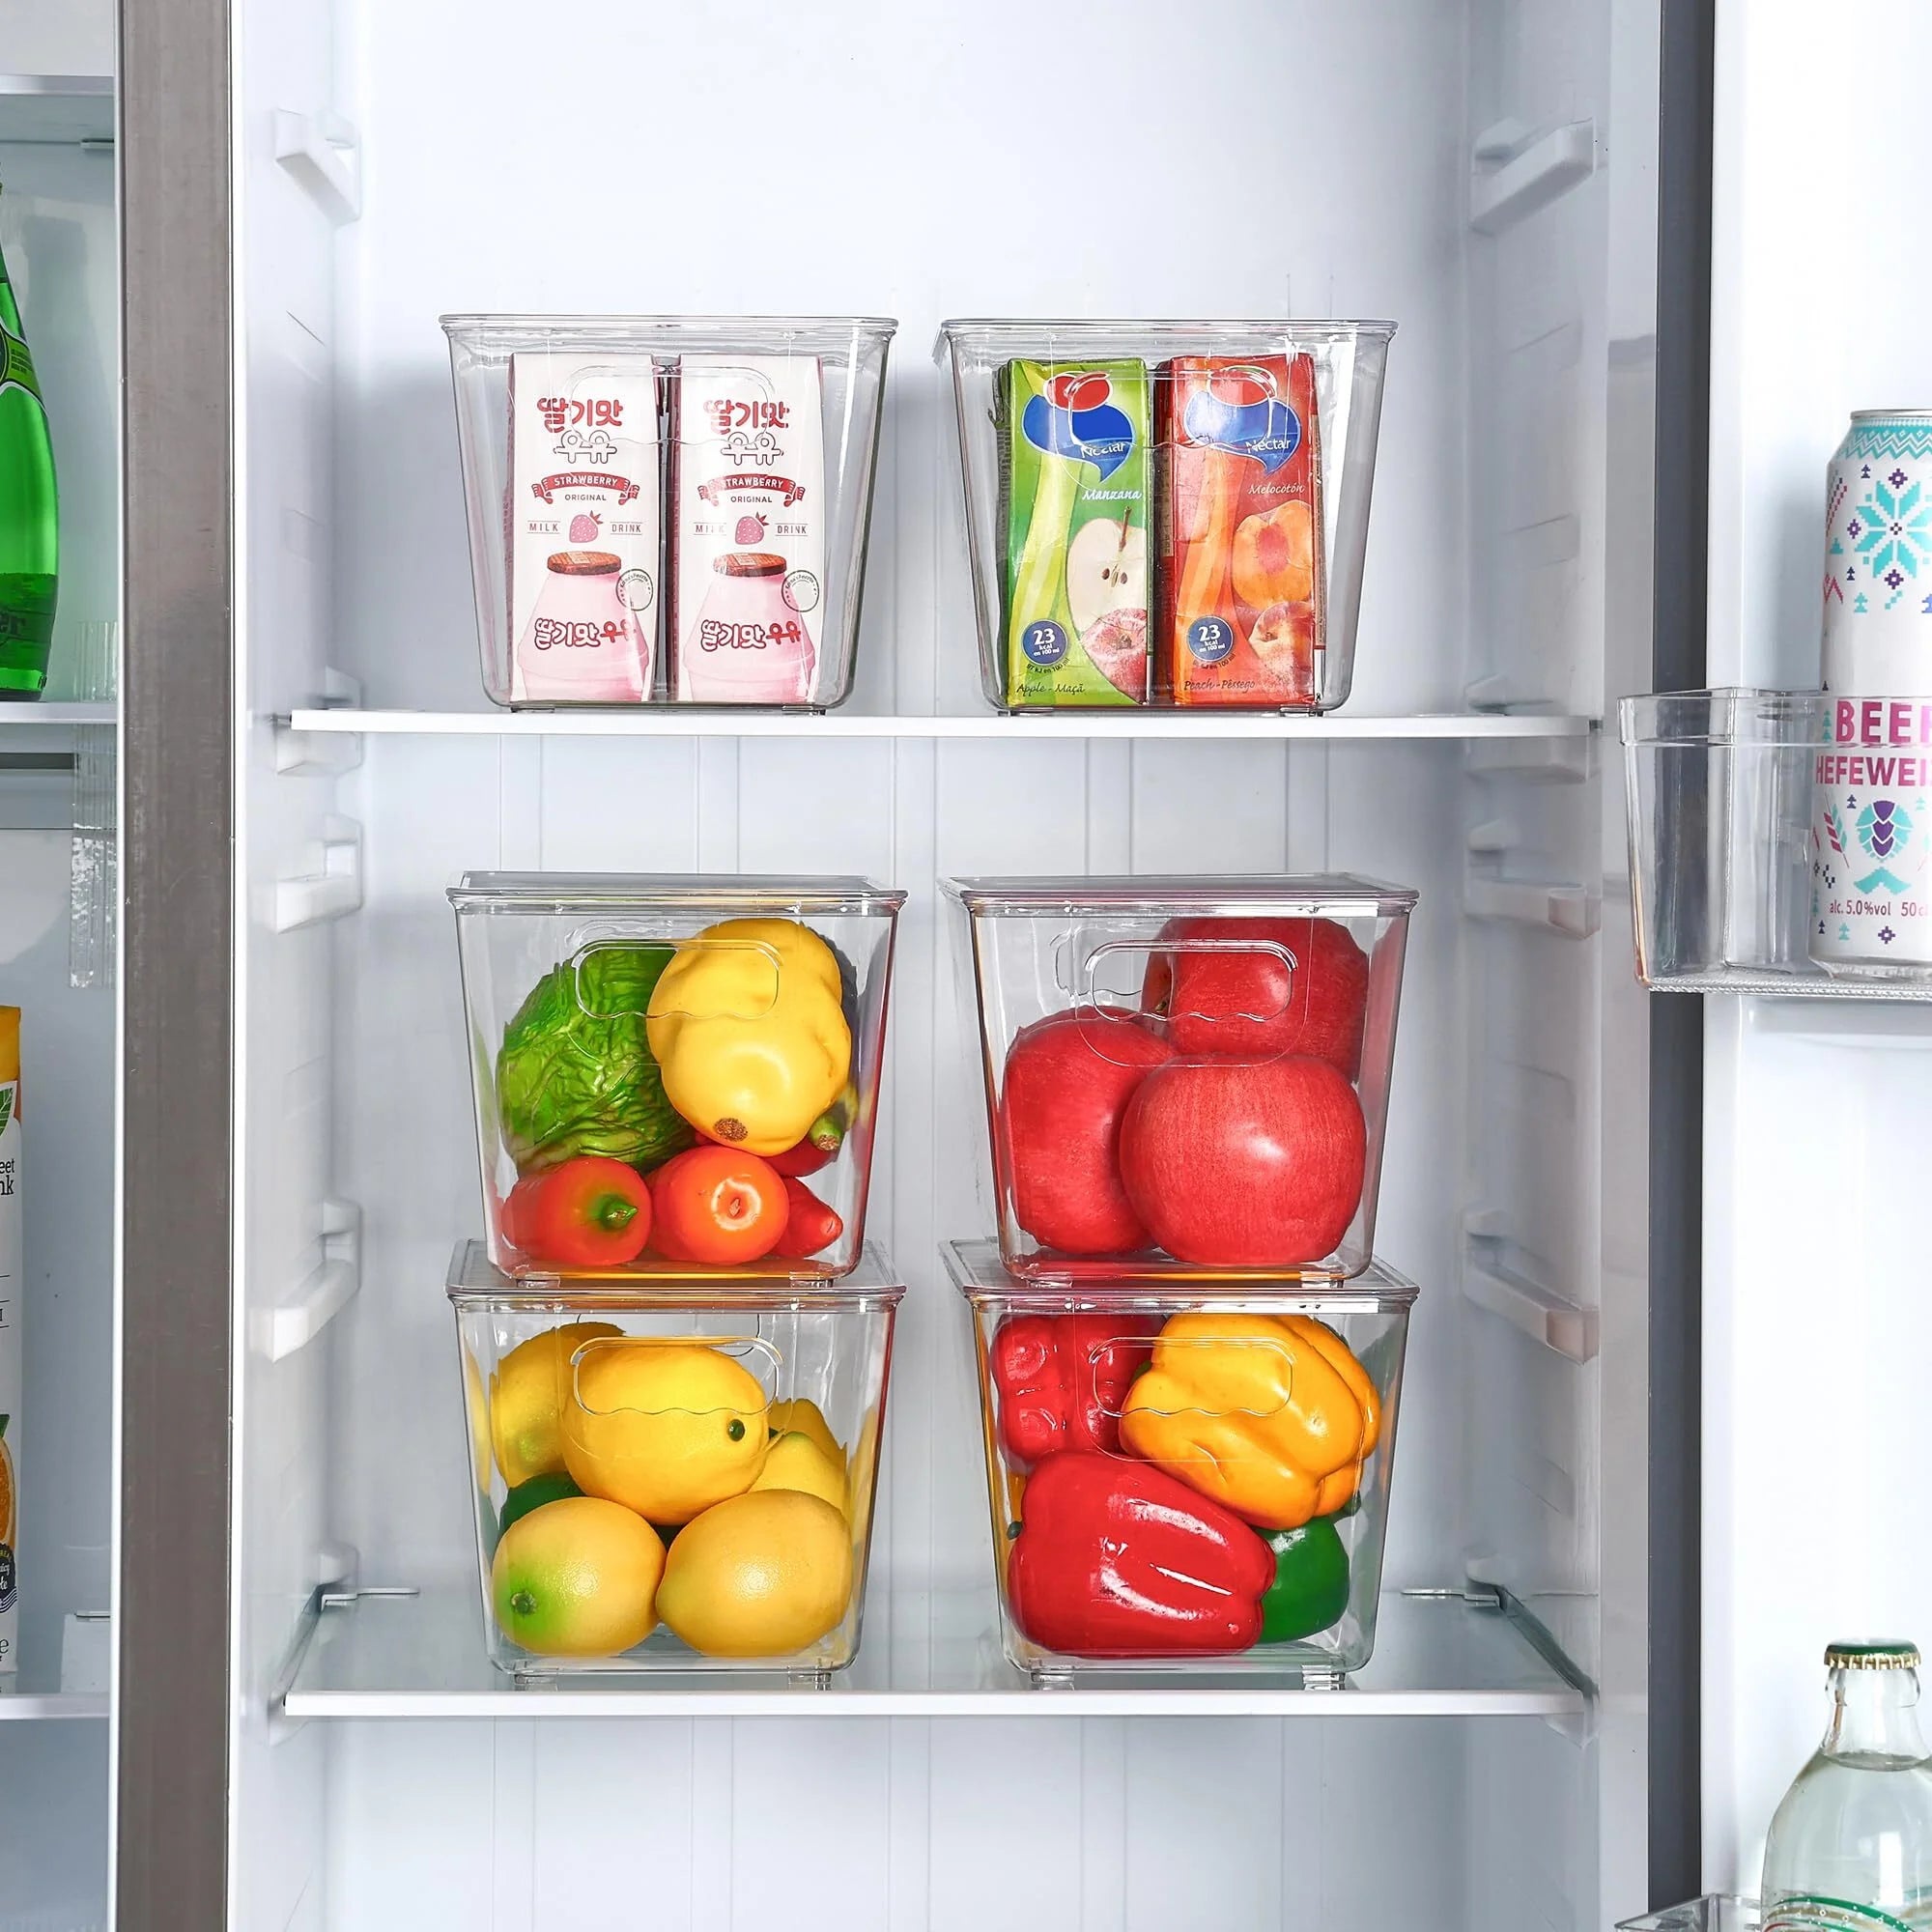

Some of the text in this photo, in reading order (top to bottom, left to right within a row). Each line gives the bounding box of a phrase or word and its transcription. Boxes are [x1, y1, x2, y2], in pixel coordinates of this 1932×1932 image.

[537, 397, 623, 433] 딸기맛
[703, 399, 790, 435] 딸기맛
[554, 430, 618, 464] 우유
[721, 432, 783, 466] 우유
[1245, 439, 1292, 454] Nectar
[554, 474, 618, 487] STRAWBERRY
[1082, 489, 1143, 500] Manzana
[1247, 482, 1305, 495] Melocotón
[529, 523, 641, 533] MILK DRINK
[777, 525, 807, 534] DRINK
[1033, 628, 1056, 645] 23
[1198, 624, 1221, 642] 23
[1217, 659, 1230, 668] 100
[1016, 681, 1045, 696] Apple
[1055, 683, 1086, 696] Maçã
[1183, 678, 1215, 691] Peach
[1221, 679, 1256, 694] Pêssego
[1816, 755, 1932, 787] HEFEWEI
[1829, 899, 1844, 914] alc.
